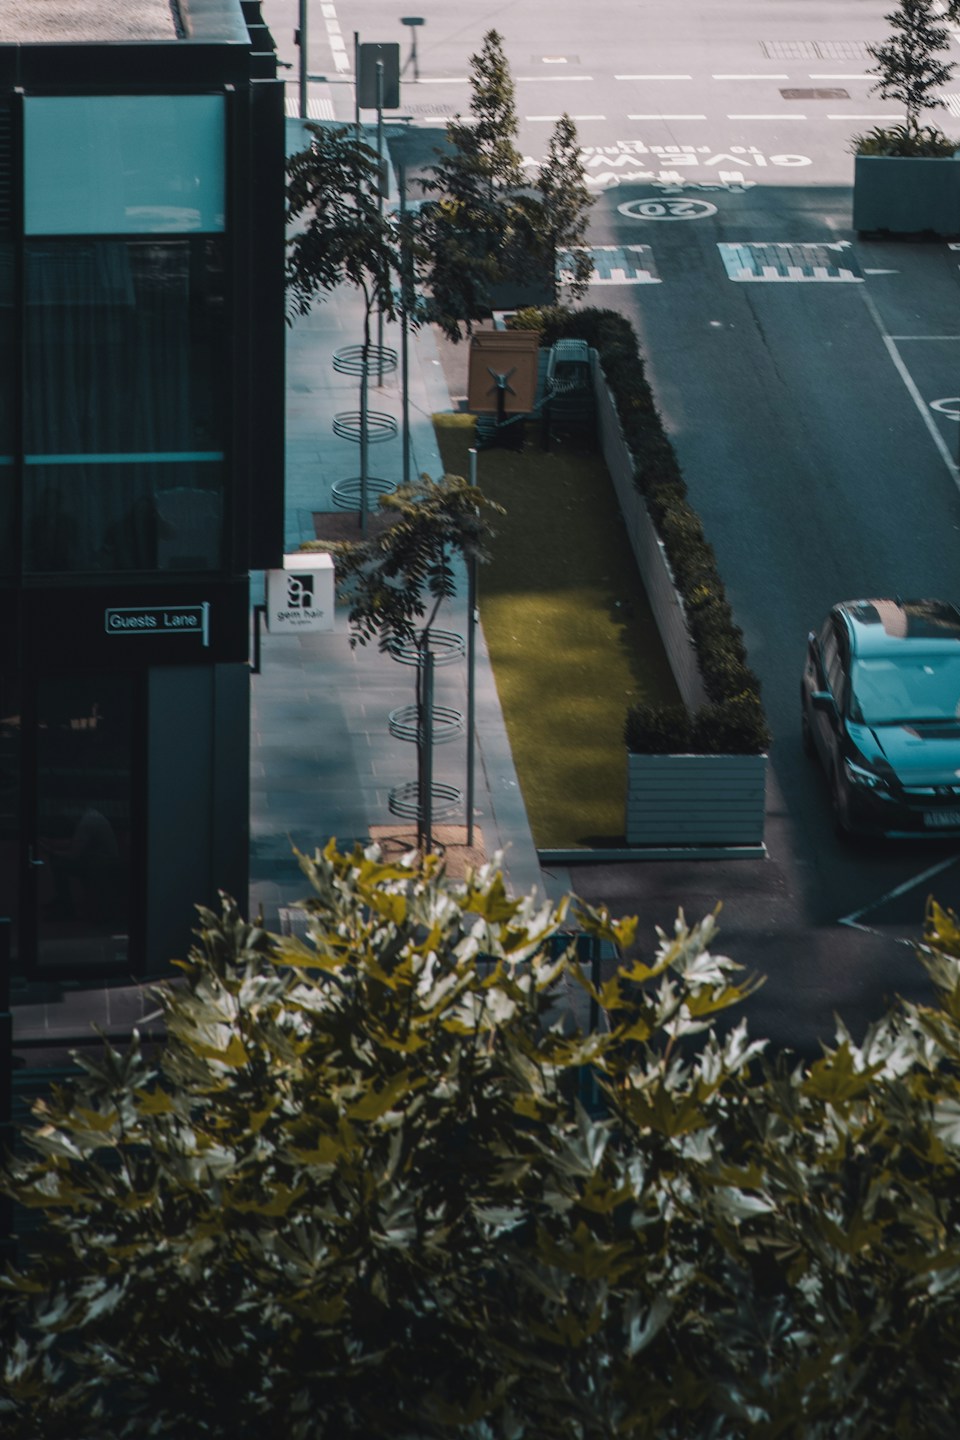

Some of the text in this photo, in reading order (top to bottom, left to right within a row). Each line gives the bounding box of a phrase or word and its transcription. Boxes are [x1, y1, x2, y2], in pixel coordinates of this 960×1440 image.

[730, 146, 763, 154] TO
[658, 154, 813, 167] GIVE
[639, 202, 696, 216] 20
[109, 613, 198, 629] Guests Lane
